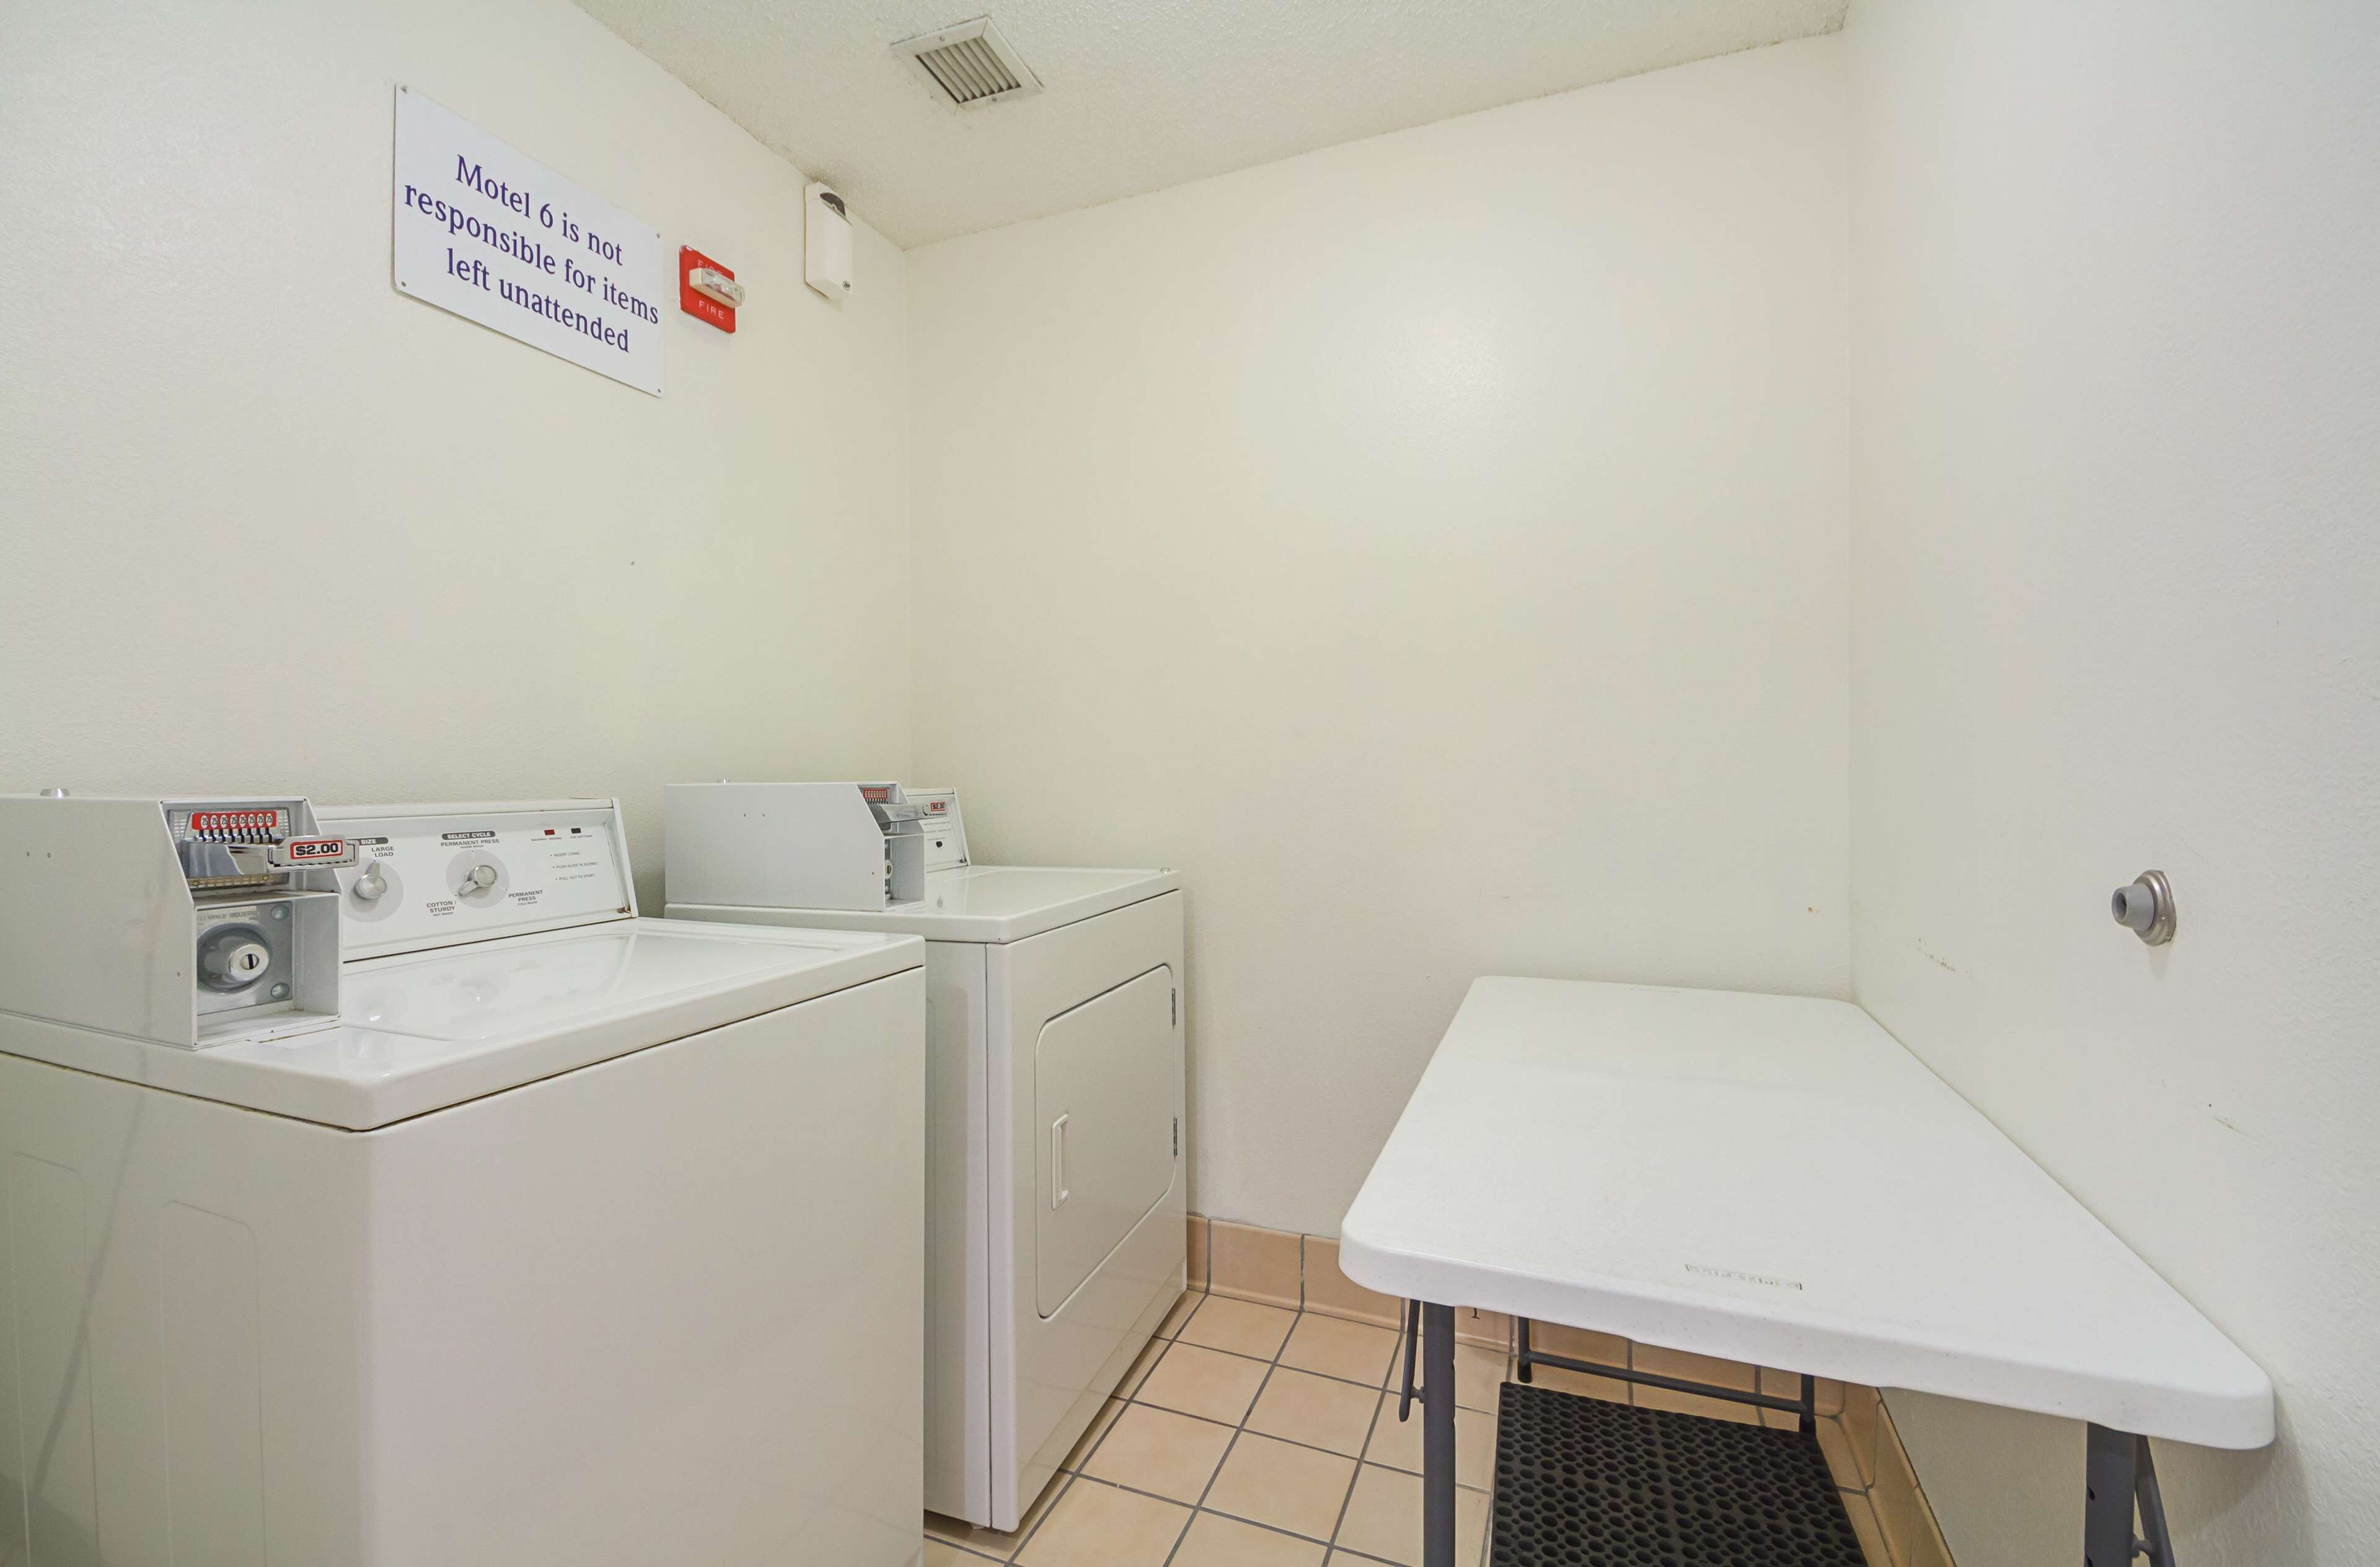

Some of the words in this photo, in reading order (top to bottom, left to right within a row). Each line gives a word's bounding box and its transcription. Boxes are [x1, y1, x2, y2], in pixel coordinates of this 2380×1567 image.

[456, 154, 531, 218] Motel
[539, 203, 553, 228] 6
[562, 212, 579, 242] is
[588, 232, 623, 266] not
[405, 184, 555, 274] responsible
[565, 259, 596, 294] for
[603, 278, 659, 324] items
[447, 248, 490, 291] left
[499, 278, 630, 353] unattended
[699, 300, 724, 320] FIRE
[202, 817, 208, 825] 25
[212, 817, 218, 825] 25
[222, 817, 227, 825] 25
[231, 817, 237, 825] 25
[240, 816, 246, 824] 25
[258, 815, 263, 823] 25
[296, 843, 339, 856] $2.00
[508, 890, 543, 898] PERMANENT
